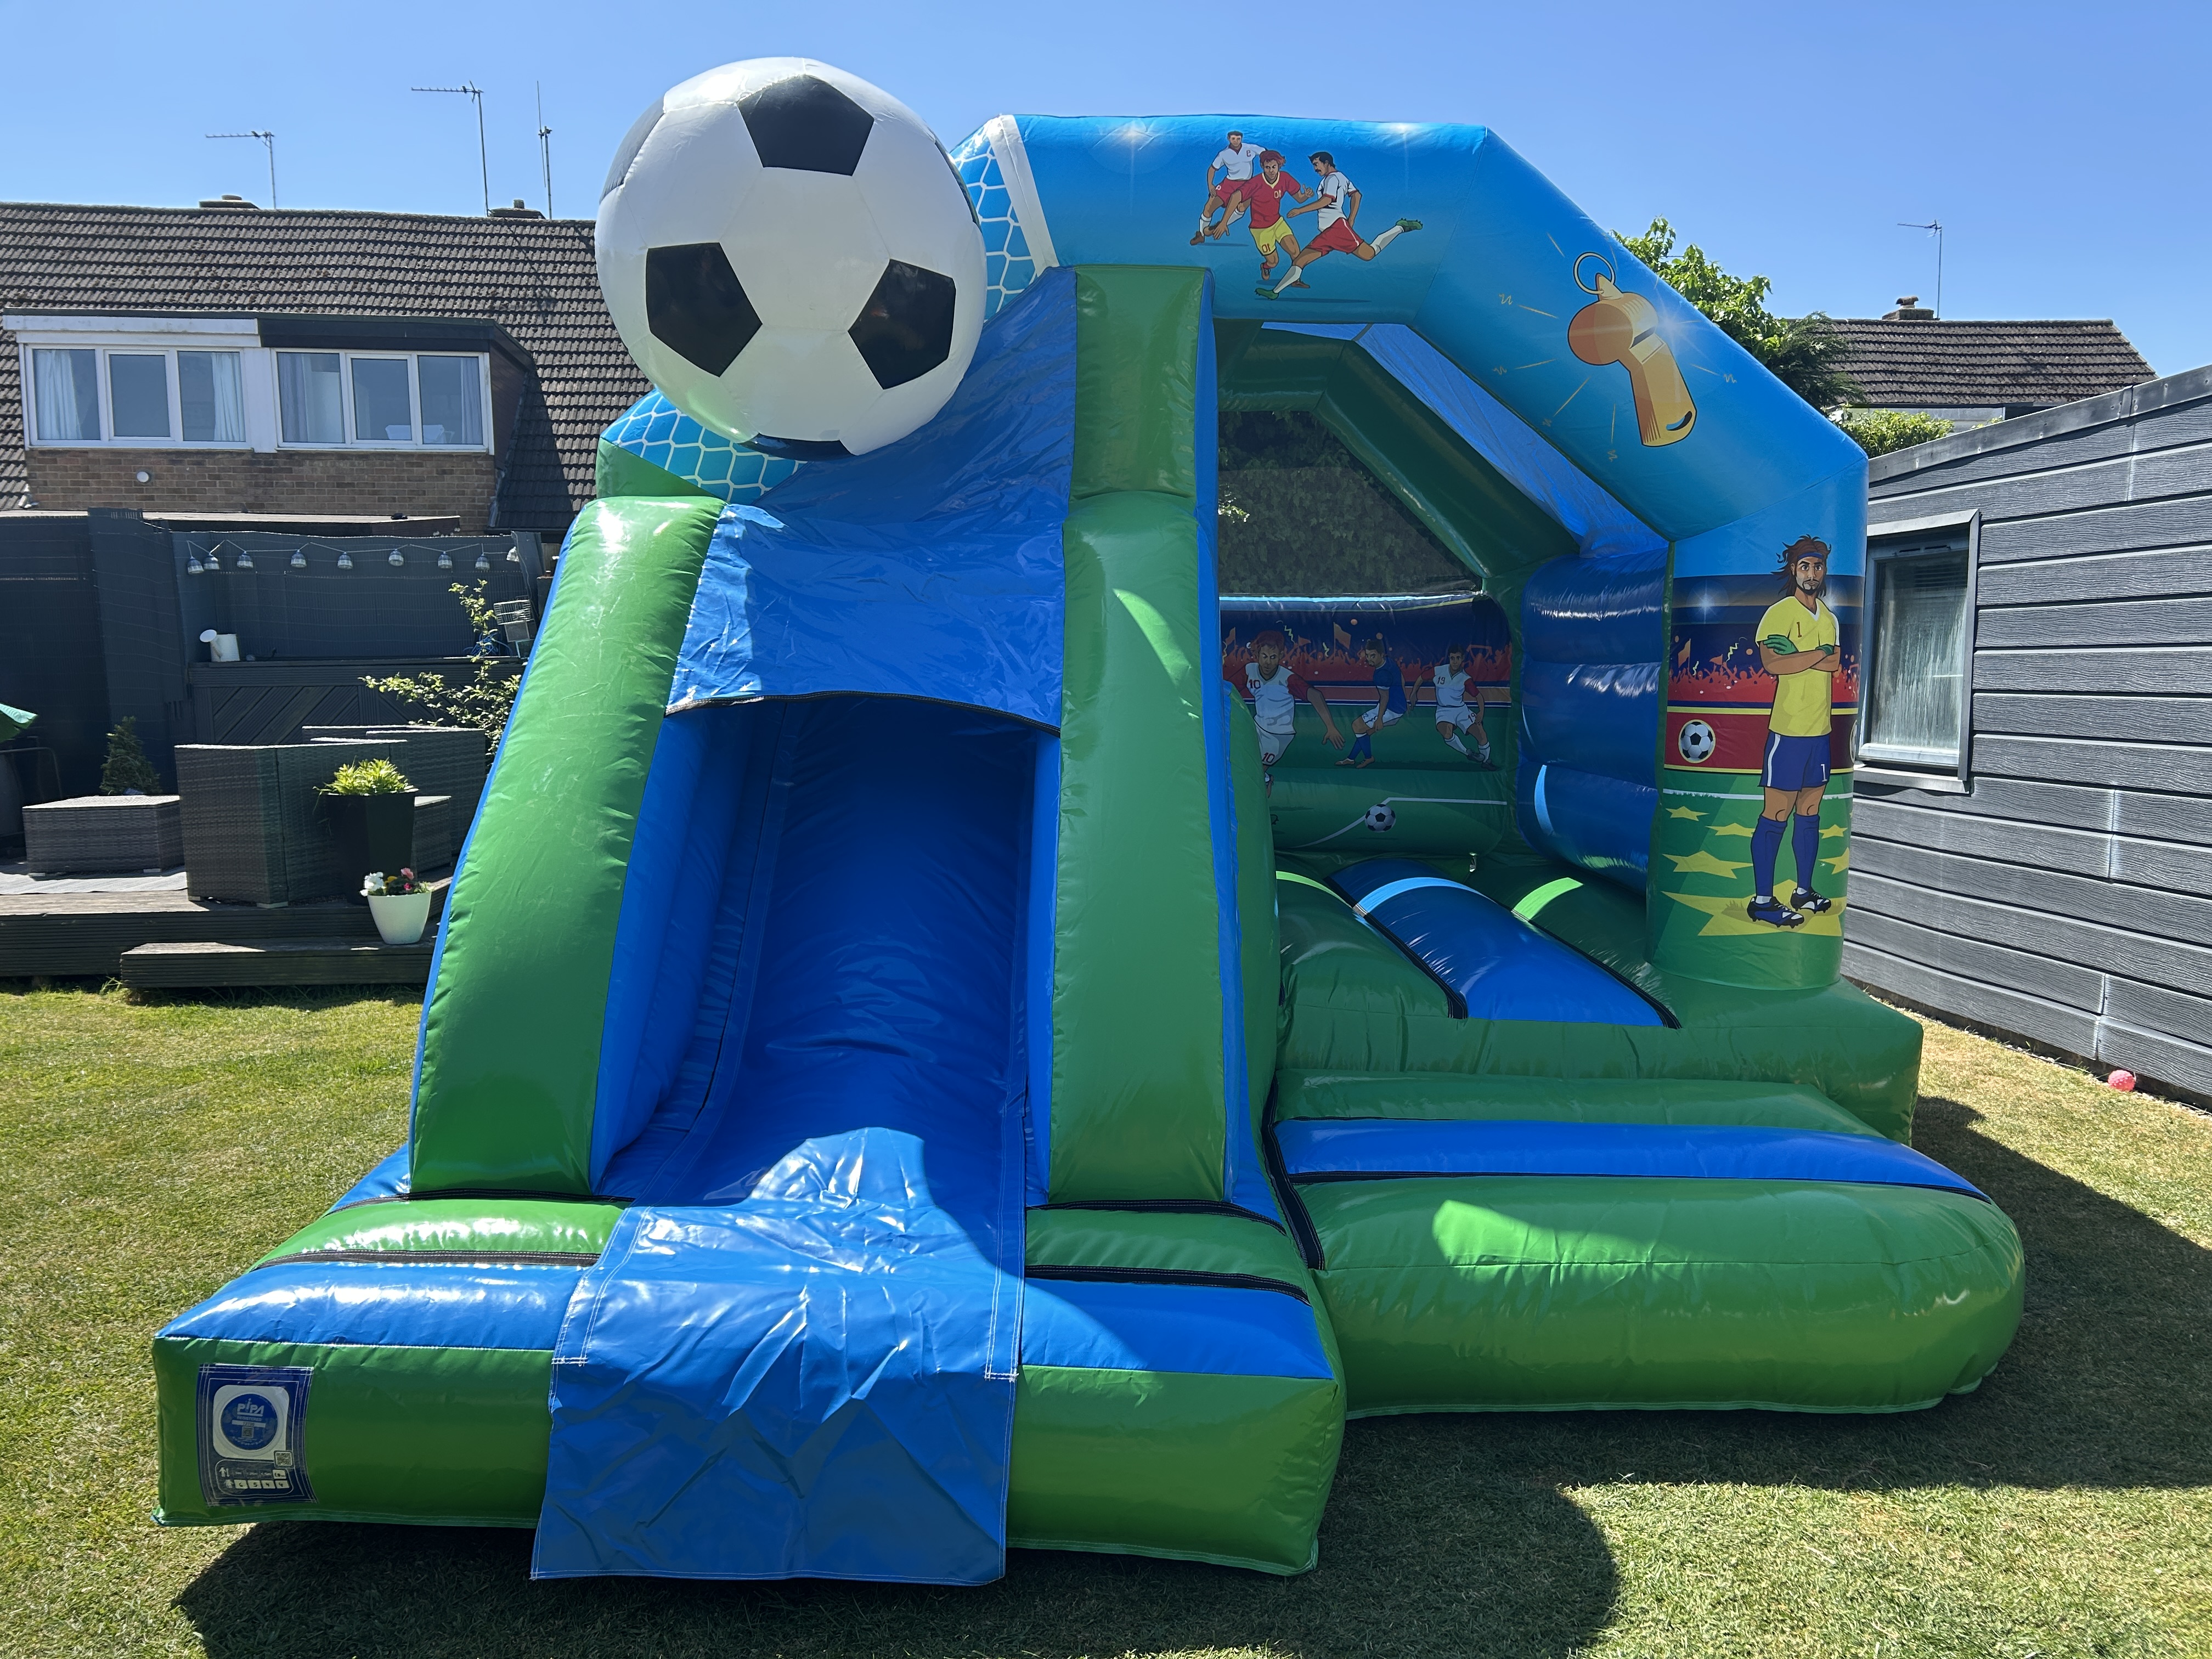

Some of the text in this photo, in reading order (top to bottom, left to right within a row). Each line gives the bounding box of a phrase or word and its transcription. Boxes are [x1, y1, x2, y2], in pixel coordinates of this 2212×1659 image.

[1796, 621, 1802, 638] 1
[1249, 679, 1261, 689] 10
[1437, 676, 1446, 685] 19
[1262, 752, 1276, 764] 10
[1820, 763, 1827, 782] 1
